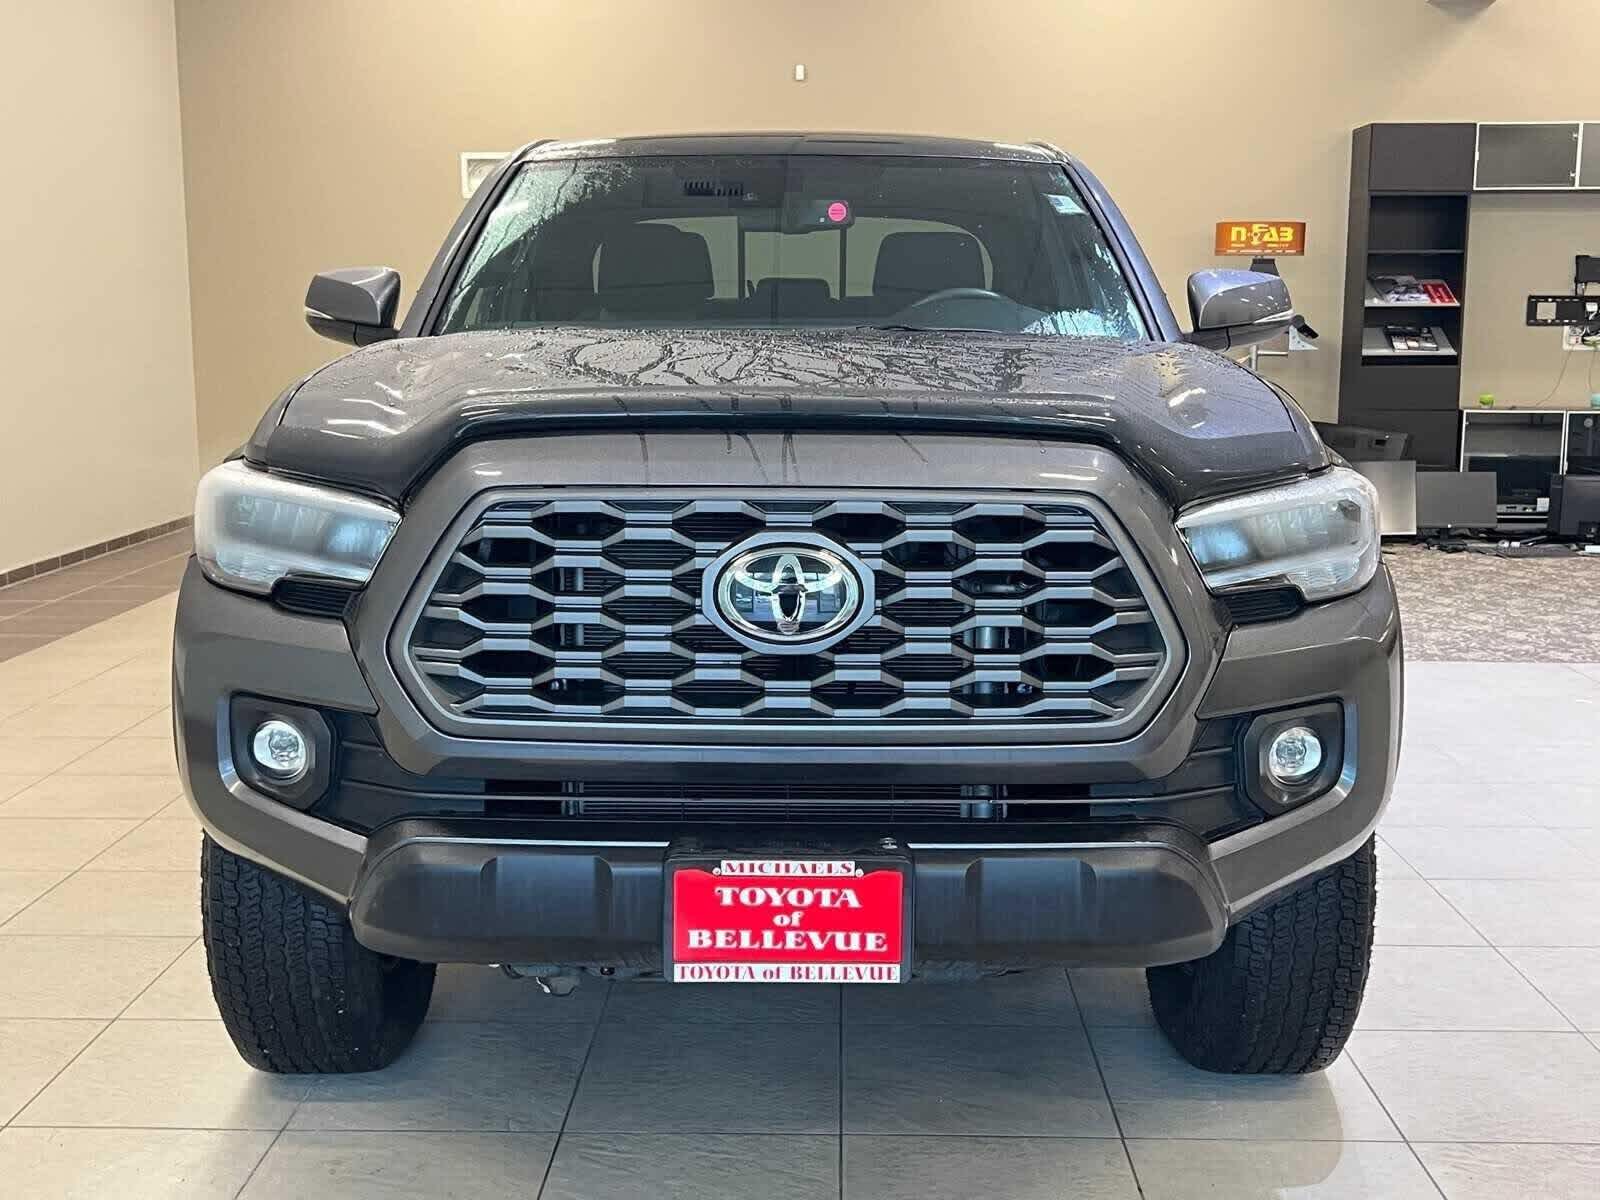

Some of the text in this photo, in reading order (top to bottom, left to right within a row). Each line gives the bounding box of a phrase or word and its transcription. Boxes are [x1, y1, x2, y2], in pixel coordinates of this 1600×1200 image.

[724, 862, 853, 875] MICHAELS
[715, 886, 862, 908] TOYOTA
[773, 911, 804, 927] of
[687, 930, 888, 952] BELLEVUE
[679, 965, 898, 981] TOYOTA of BELLEVUE
